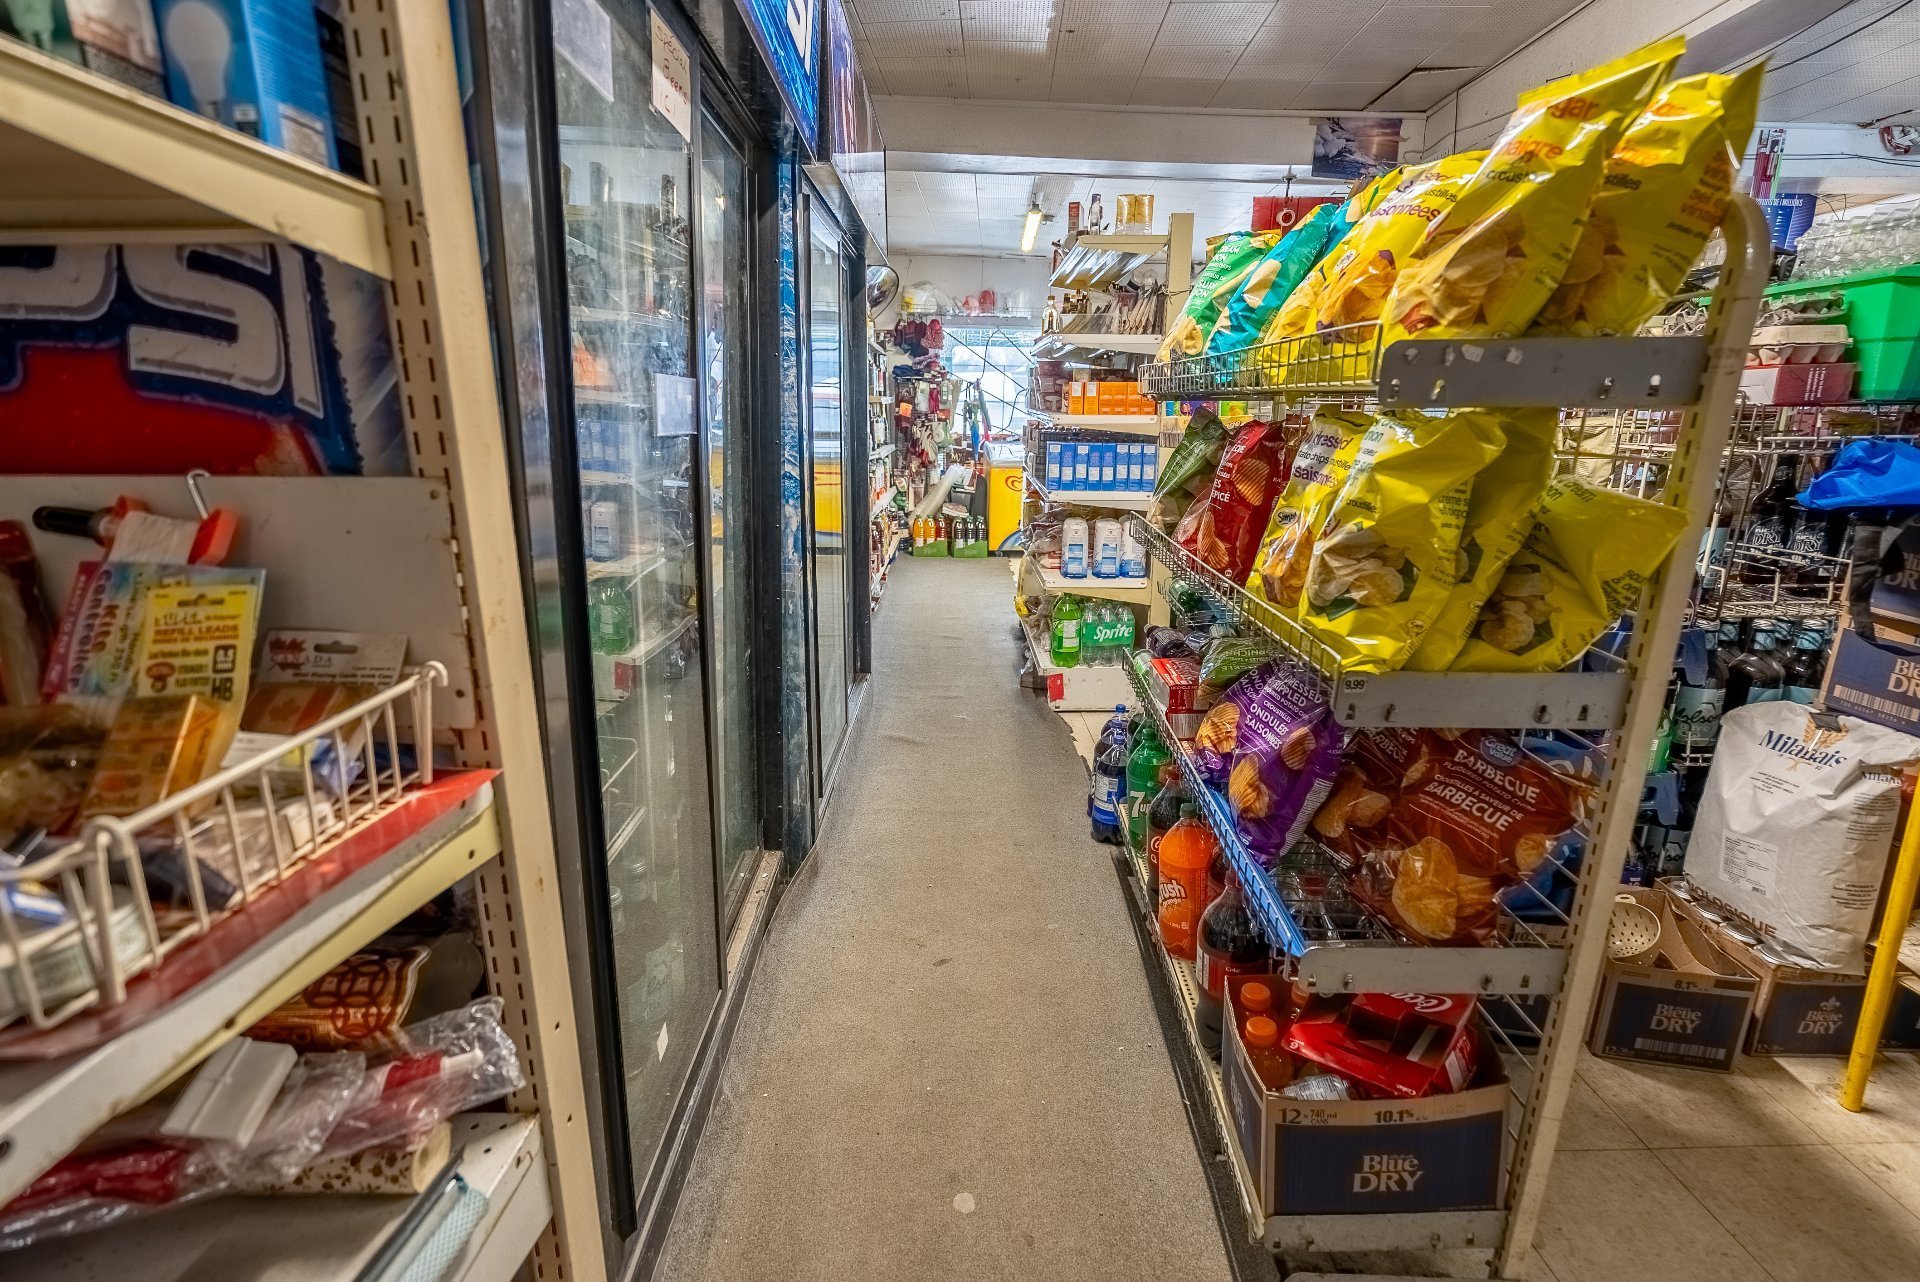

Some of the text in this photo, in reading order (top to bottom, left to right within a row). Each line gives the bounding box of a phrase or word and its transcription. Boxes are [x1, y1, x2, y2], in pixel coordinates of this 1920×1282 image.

[1093, 623, 1133, 643] Sprite
[211, 677, 235, 701] HB
[1286, 675, 1323, 704] DRESSED
[1345, 679, 1365, 690] 9.99
[1485, 736, 1518, 756] Great
[1489, 745, 1513, 764] Value
[1758, 729, 1848, 768] Milanais
[1453, 749, 1540, 804] BARBECUE
[1434, 774, 1474, 793] CROUSTILLES
[1480, 793, 1512, 813] SAVEUR
[1512, 810, 1525, 821] DE
[1483, 780, 1511, 800] POTATO
[1423, 781, 1514, 832] BARBECUE
[1162, 897, 1183, 909] orange
[1225, 966, 1241, 974] Coke
[1655, 1003, 1702, 1021] Bleue
[1649, 1015, 1701, 1035] DRY
[1797, 1021, 1843, 1035] DRY
[1277, 1108, 1302, 1125] 12
[1310, 1108, 1326, 1119] 740
[1326, 1111, 1338, 1120] ml
[1374, 1109, 1415, 1124] 10.1%
[1361, 1154, 1420, 1173] Blue
[1352, 1170, 1425, 1193] DRY
